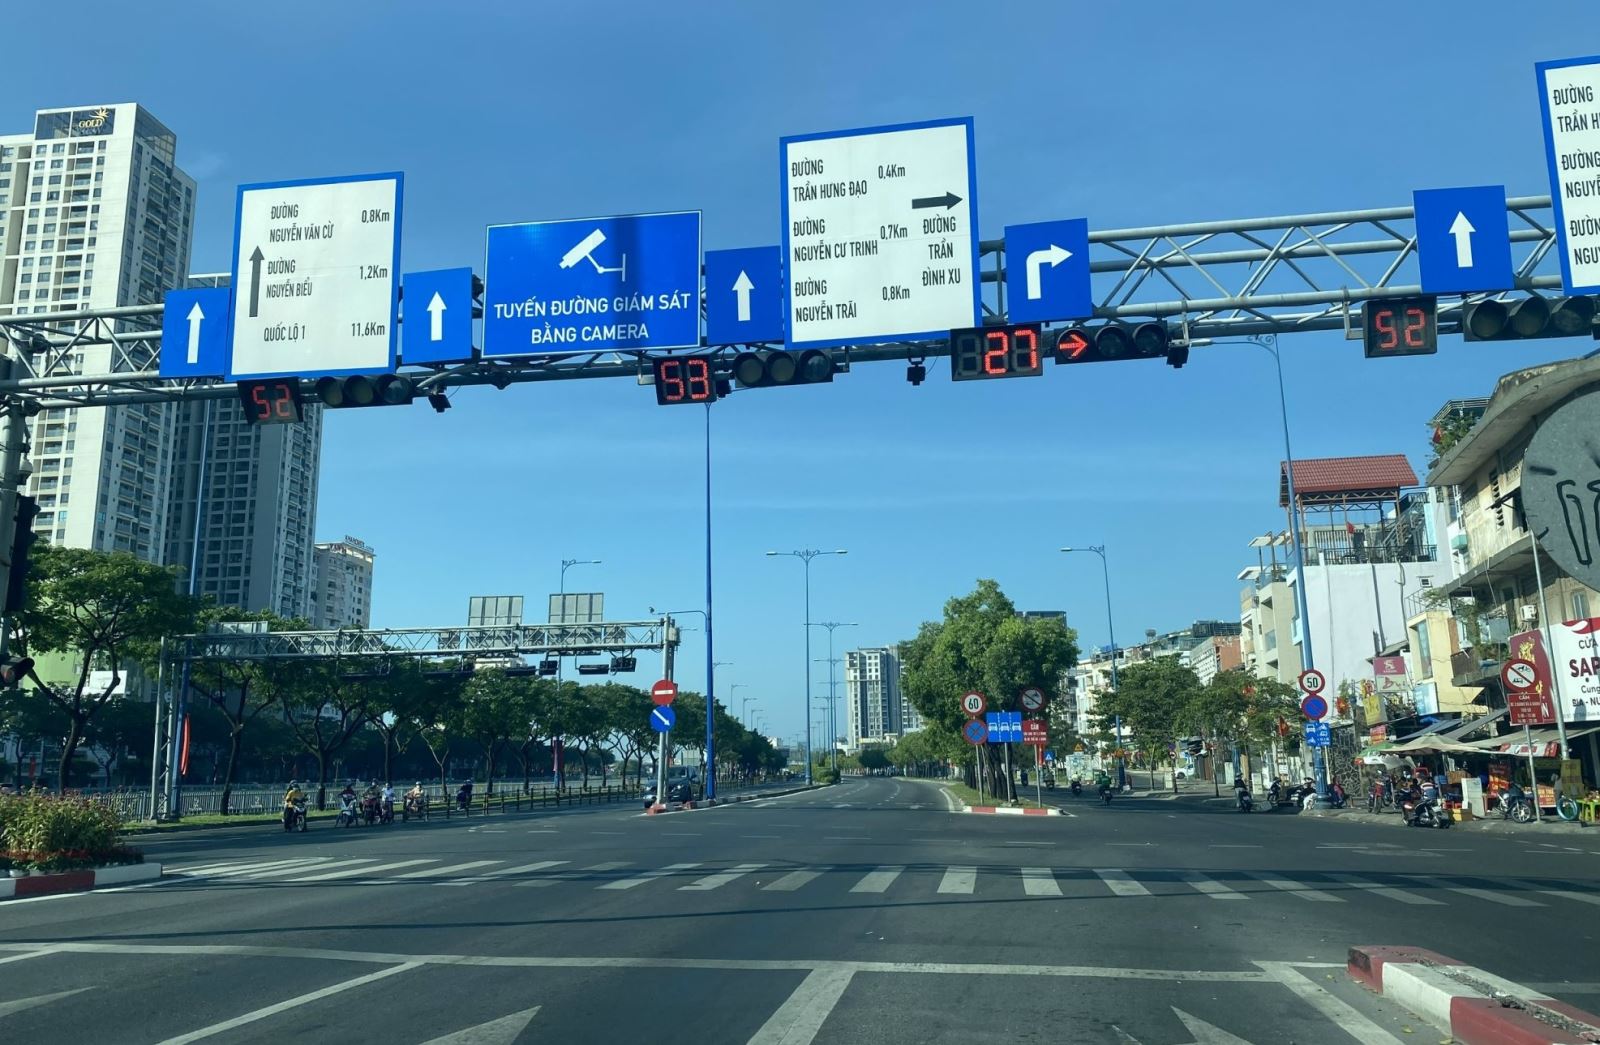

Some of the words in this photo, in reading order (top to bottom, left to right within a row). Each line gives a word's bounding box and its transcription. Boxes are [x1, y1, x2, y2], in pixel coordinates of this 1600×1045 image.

[1552, 83, 1594, 105] ĐƯỜNG
[79, 119, 103, 128] GOLD
[1557, 109, 1588, 133] TRẦN
[1591, 112, 1600, 130] H
[791, 157, 824, 177] ĐƯỜNG
[1561, 148, 1600, 171] ĐƯỜNG
[793, 180, 818, 202] TRẦN
[819, 182, 846, 199] HƯNG
[848, 180, 868, 198] ĐẠO
[270, 201, 299, 220] ĐƯỜNG
[269, 222, 302, 243] NGUYỄN
[304, 223, 321, 241] VĂN
[322, 219, 335, 239] CỪ
[793, 216, 826, 237] ĐƯỜNG
[923, 213, 956, 234] ĐƯỜNG
[794, 239, 832, 262] NGUYỄN
[834, 242, 847, 259] CƯ
[849, 240, 879, 257] TRINH
[928, 237, 954, 260] TRẦN
[1574, 246, 1600, 265] NGU
[267, 256, 296, 275] ĐƯỜNG
[922, 266, 945, 287] ĐÌNH
[948, 268, 961, 285] XU
[266, 278, 294, 299] NGUYỄN
[295, 276, 313, 297] BIỂU
[794, 276, 828, 297] ĐƯỜNG
[494, 295, 547, 319] TUYẾN
[550, 294, 609, 316] ĐƯỜNG
[613, 291, 654, 312] GIÁM
[658, 289, 691, 310] SÁT
[795, 300, 833, 323] NGUYỄN
[835, 300, 857, 319] TRÃI
[263, 321, 286, 342] QUỐC
[288, 322, 299, 343] LỘ
[301, 325, 306, 340] 1
[531, 321, 577, 344] BẰNG
[581, 323, 649, 342] CAMERA
[1375, 308, 1426, 349] 52
[984, 329, 1038, 374] 27
[661, 359, 709, 400] 53
[252, 384, 290, 419] 52
[1306, 677, 1319, 688] 50
[968, 698, 979, 710] 60
